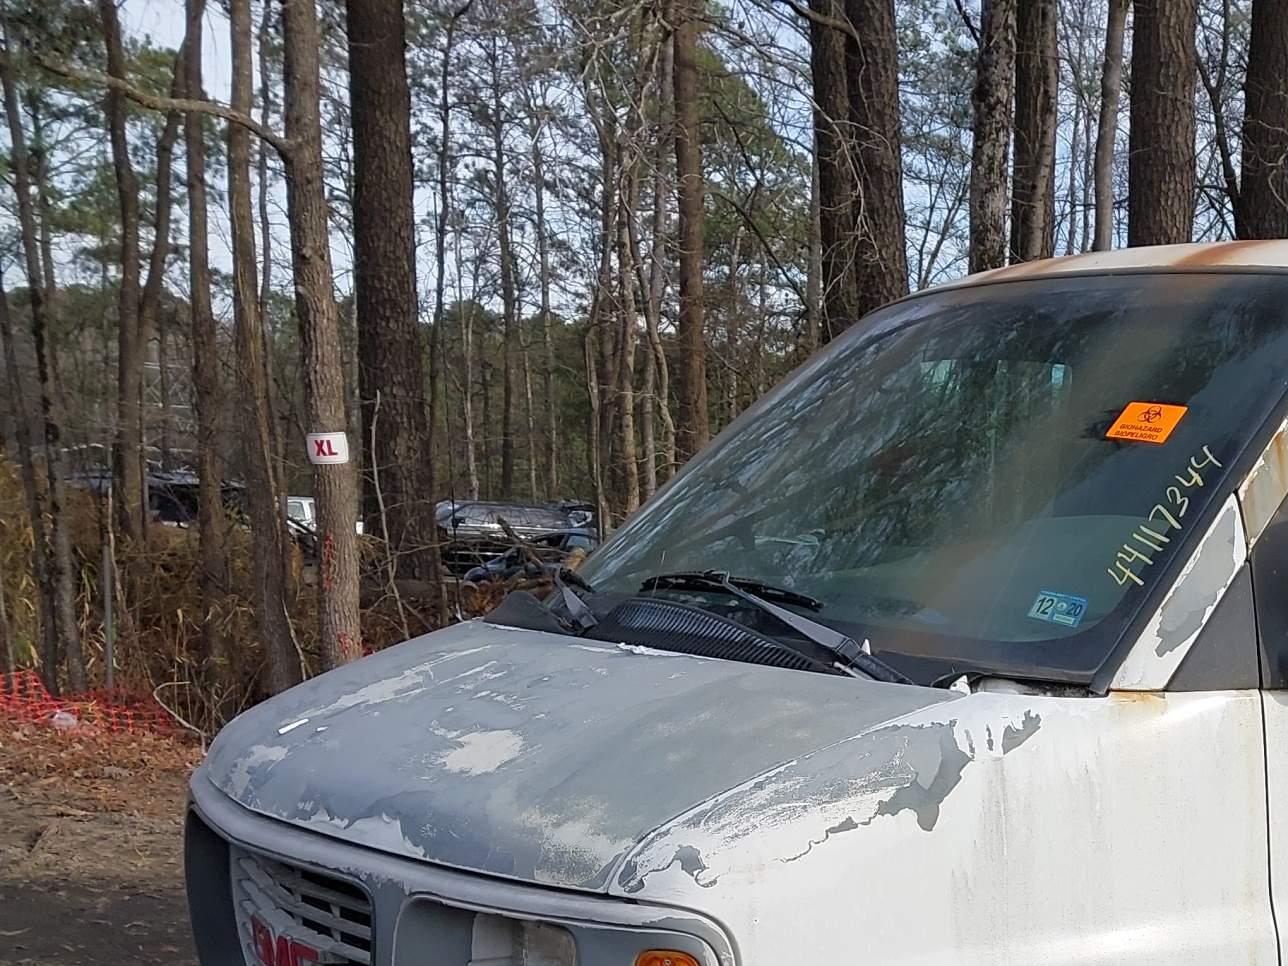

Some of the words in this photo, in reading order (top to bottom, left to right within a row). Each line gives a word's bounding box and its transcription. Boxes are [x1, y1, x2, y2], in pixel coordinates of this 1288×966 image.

[1114, 430, 1159, 441] BIOPELIGRO
[1120, 423, 1163, 434] BIOHAZARD
[314, 439, 339, 457] XL
[1107, 445, 1222, 586] 44117344
[1036, 597, 1055, 615] 12
[1066, 602, 1083, 617] 20
